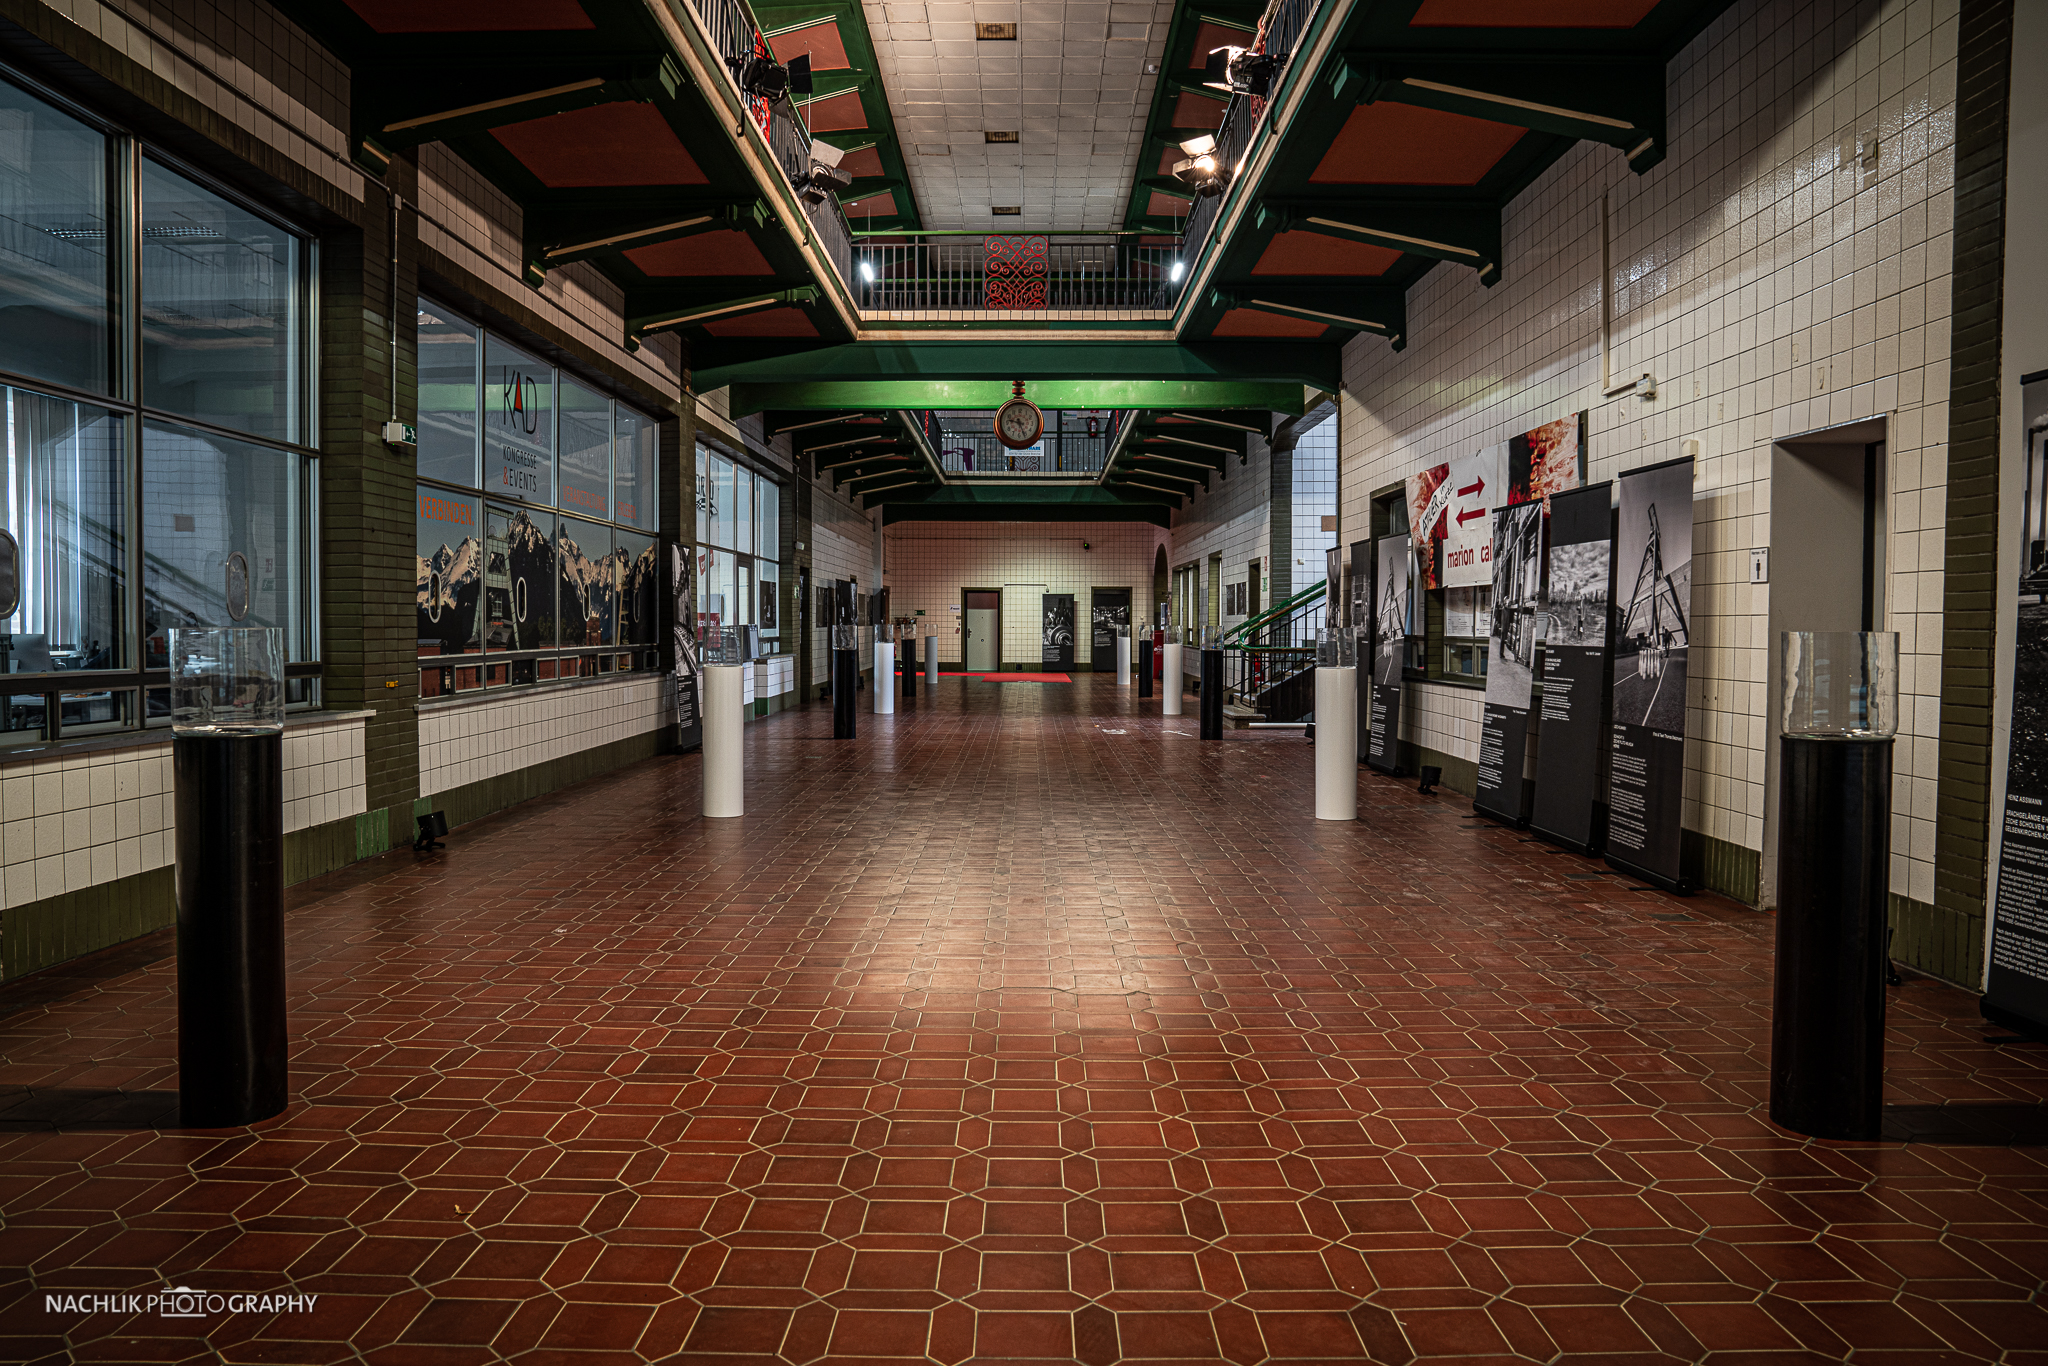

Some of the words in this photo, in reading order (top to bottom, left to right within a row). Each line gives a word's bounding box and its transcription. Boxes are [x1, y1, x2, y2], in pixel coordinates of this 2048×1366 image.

[503, 365, 538, 435] KAD
[503, 444, 537, 469] KONGRESSE
[419, 495, 475, 526] VERBINDEN.
[563, 485, 607, 512] VERANSTALTUNG.
[1447, 544, 1475, 568] marion
[2008, 794, 2019, 802] HEINZ
[2019, 796, 2042, 805] ASSMANN
[2006, 809, 2041, 822] BRACHGELÄNDE
[2006, 817, 2018, 825] ZECHE
[2019, 820, 2045, 830] SCHOLVEN
